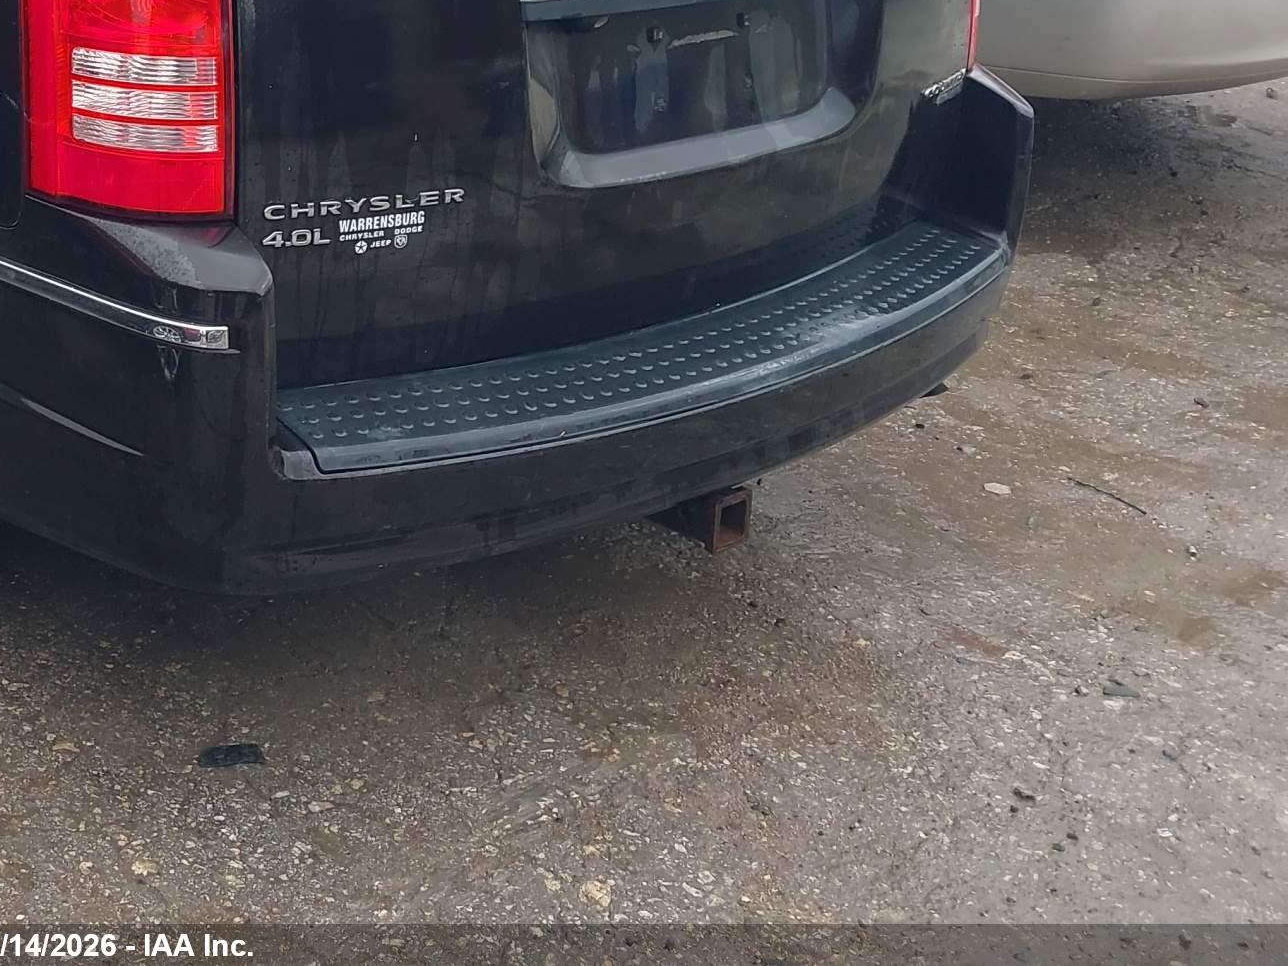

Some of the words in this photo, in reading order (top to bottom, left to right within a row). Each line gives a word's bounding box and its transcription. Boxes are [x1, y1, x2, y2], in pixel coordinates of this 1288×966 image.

[263, 188, 465, 220] CHRYSLER
[338, 210, 425, 234] WARRENSBURG
[262, 228, 331, 248] 4.0L
[339, 230, 385, 242] CHRYSLER
[394, 224, 423, 235] DODGE
[370, 239, 392, 249] JEEP
